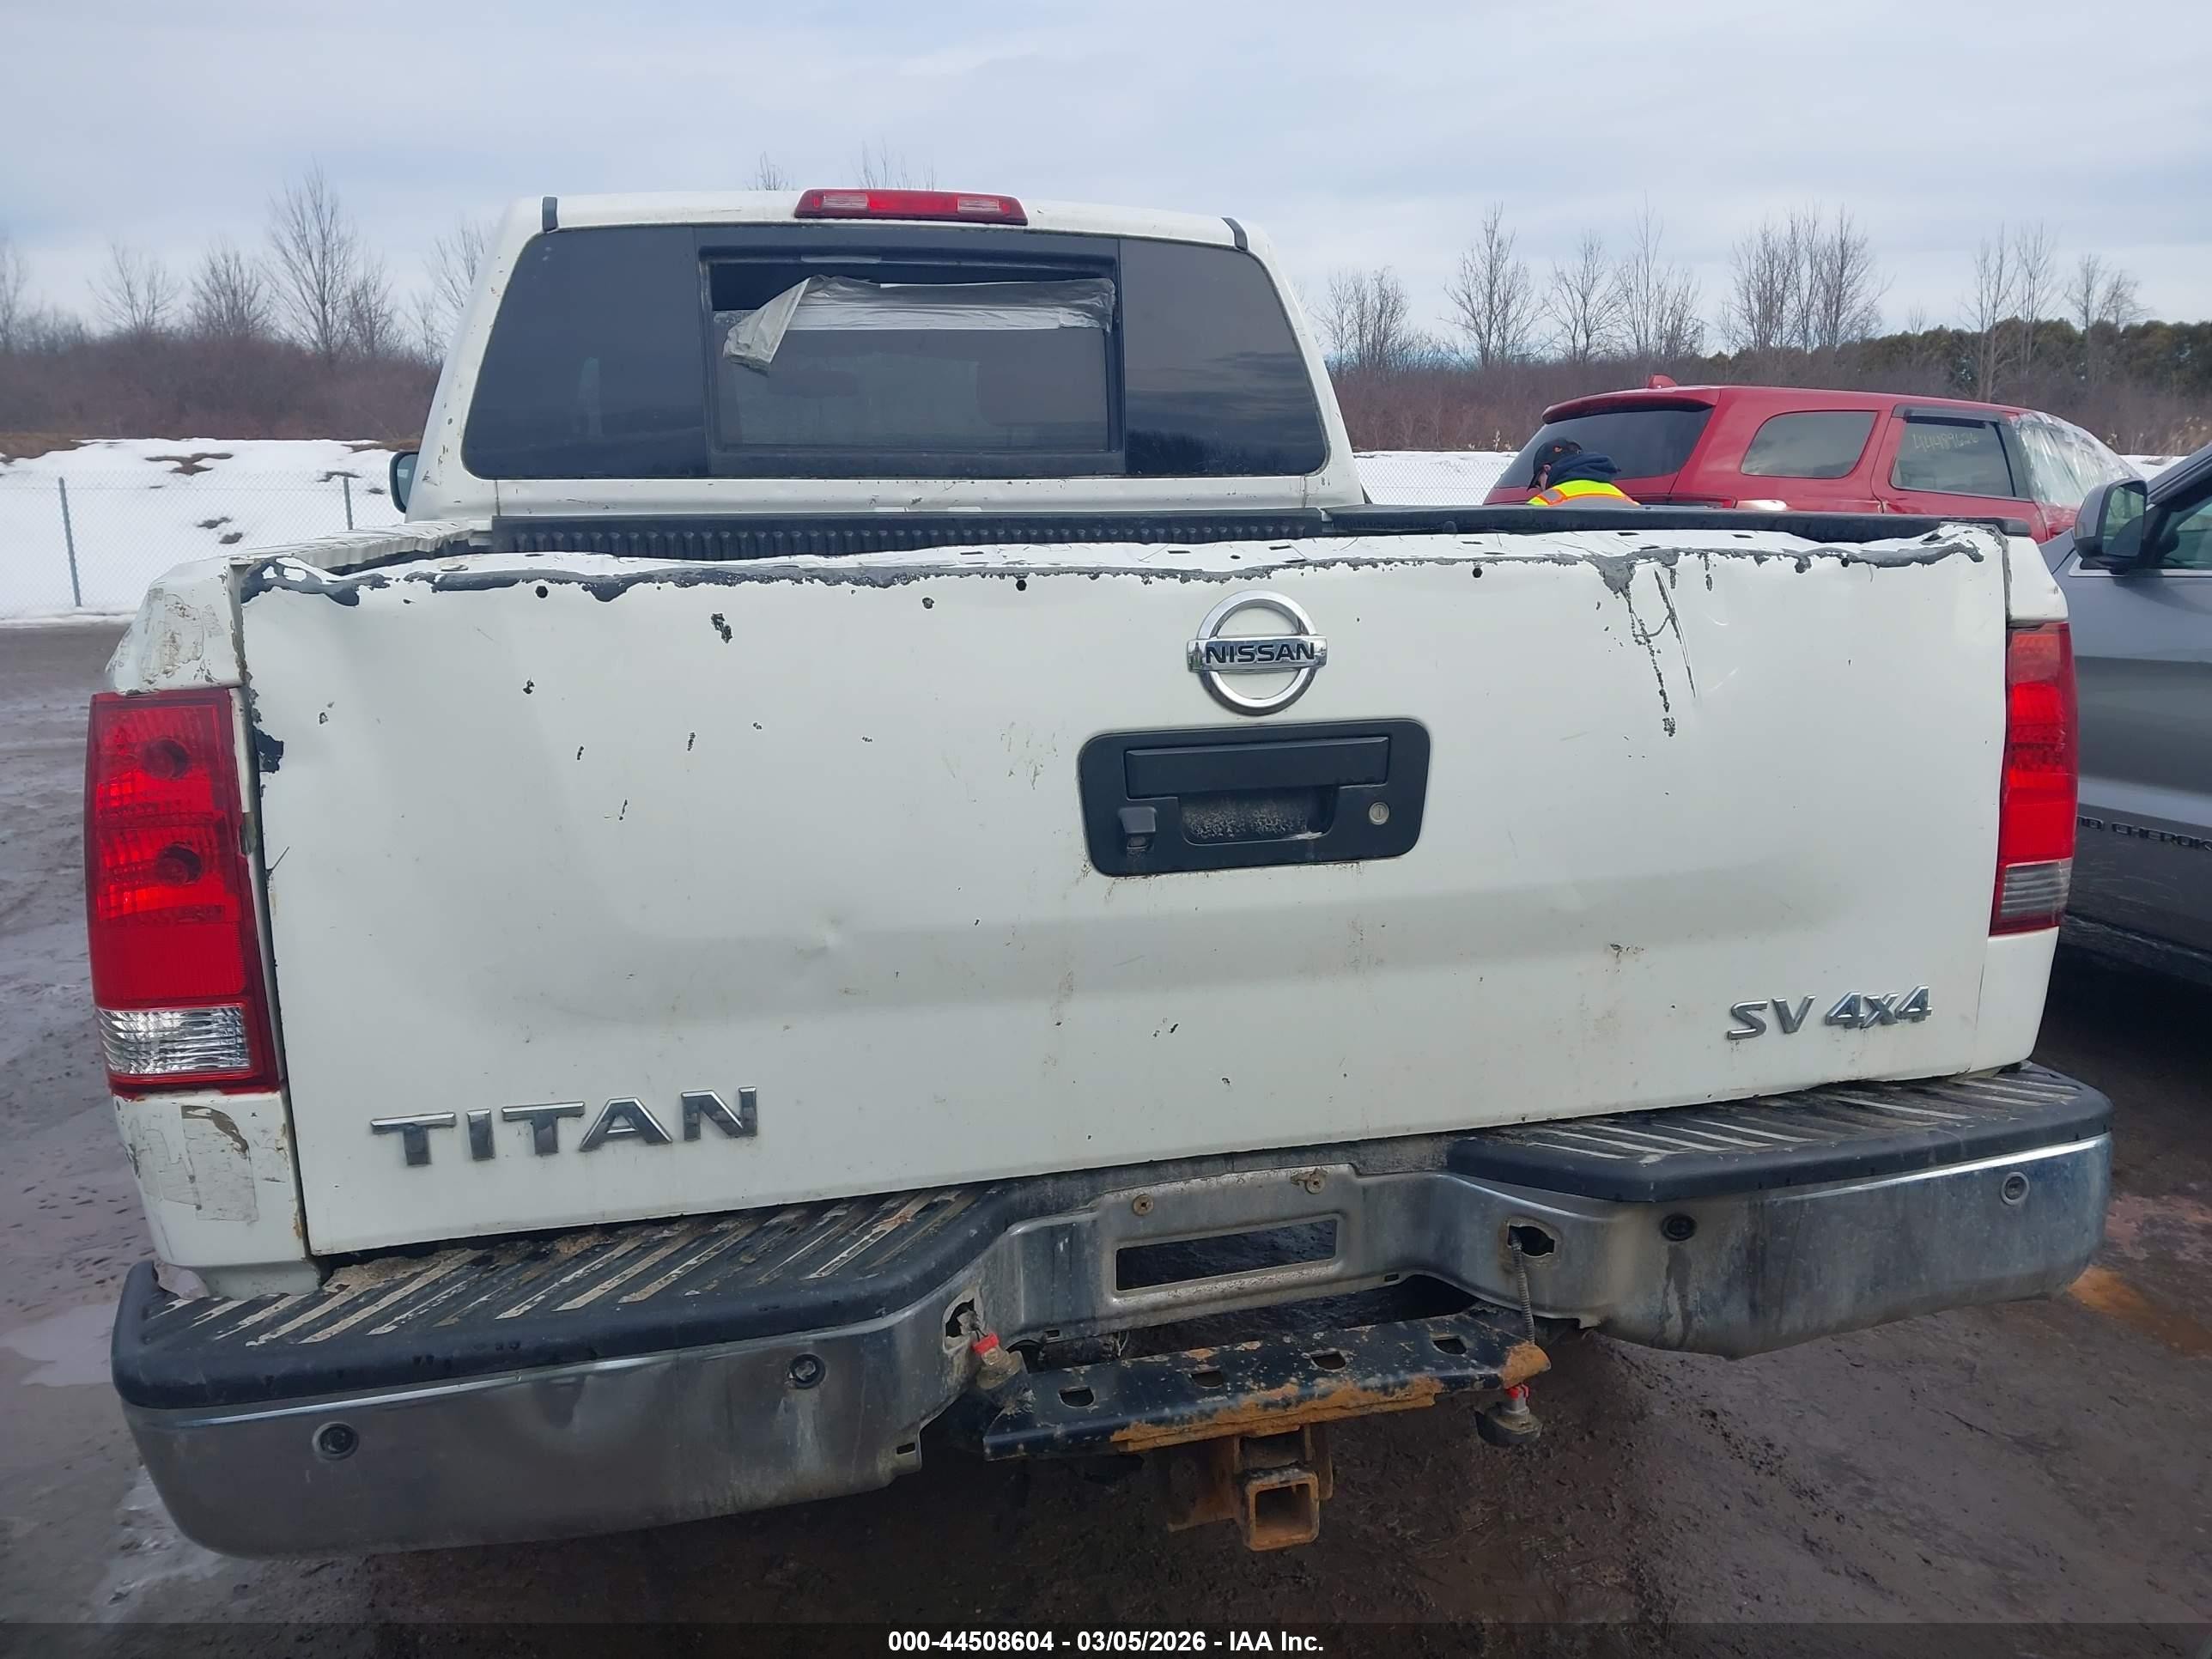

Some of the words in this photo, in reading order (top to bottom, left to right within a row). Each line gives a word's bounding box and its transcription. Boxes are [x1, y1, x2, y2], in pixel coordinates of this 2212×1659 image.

[1206, 642, 1315, 664] NISSAN
[1727, 994, 1817, 1040] SV
[371, 1086, 757, 1165] TITAN
